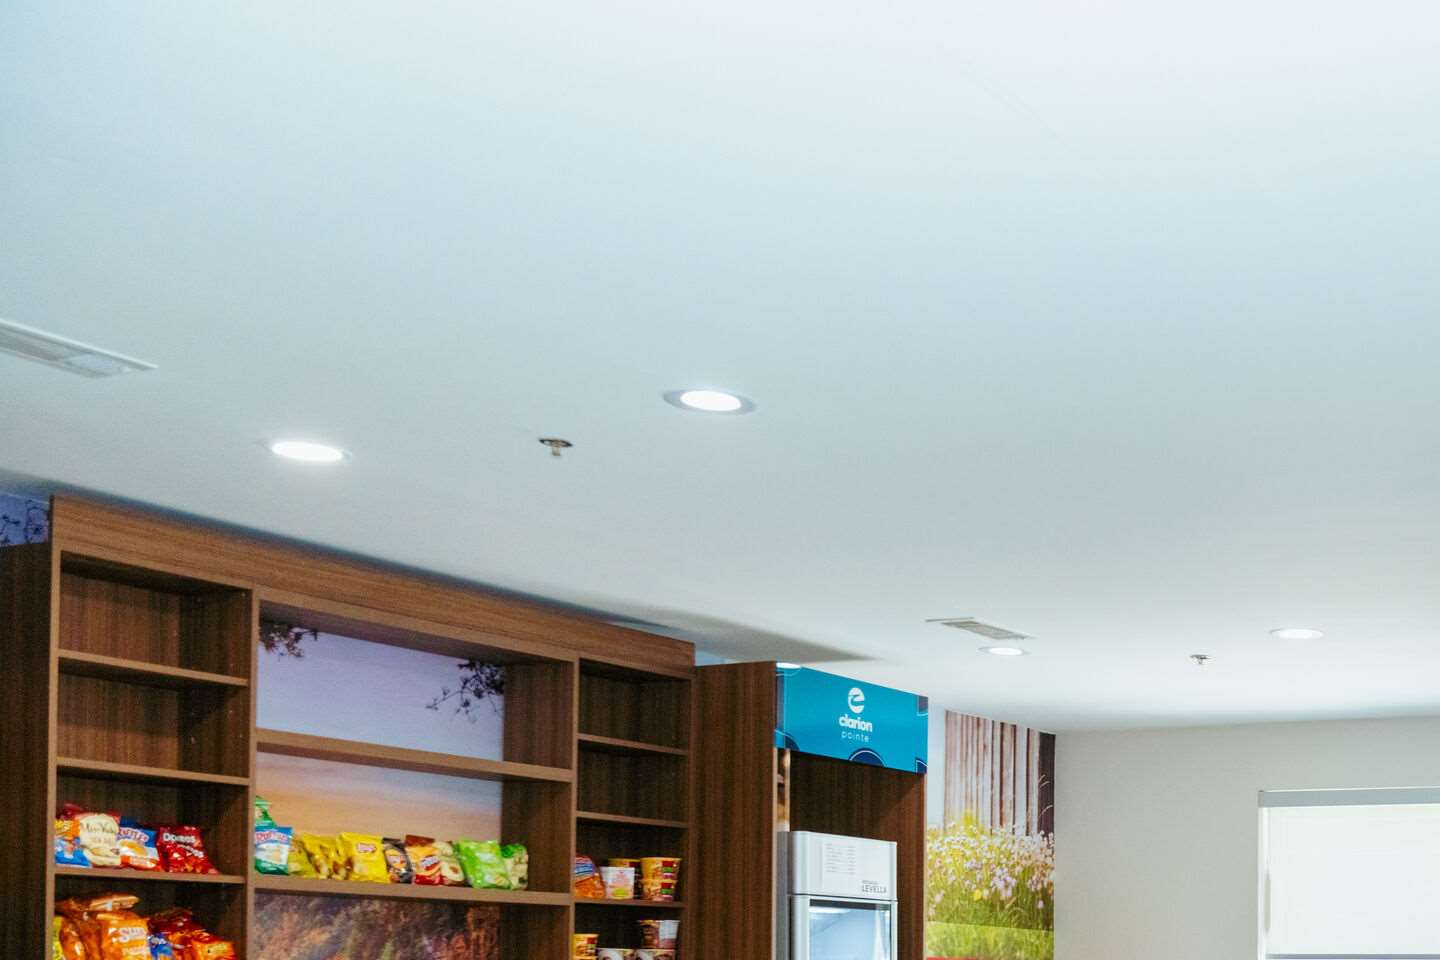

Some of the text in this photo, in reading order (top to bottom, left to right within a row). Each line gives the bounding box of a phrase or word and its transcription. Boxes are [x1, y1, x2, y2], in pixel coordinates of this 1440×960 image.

[839, 714, 873, 732] clarion
[841, 730, 869, 742] pointe
[162, 832, 197, 844] Doritos
